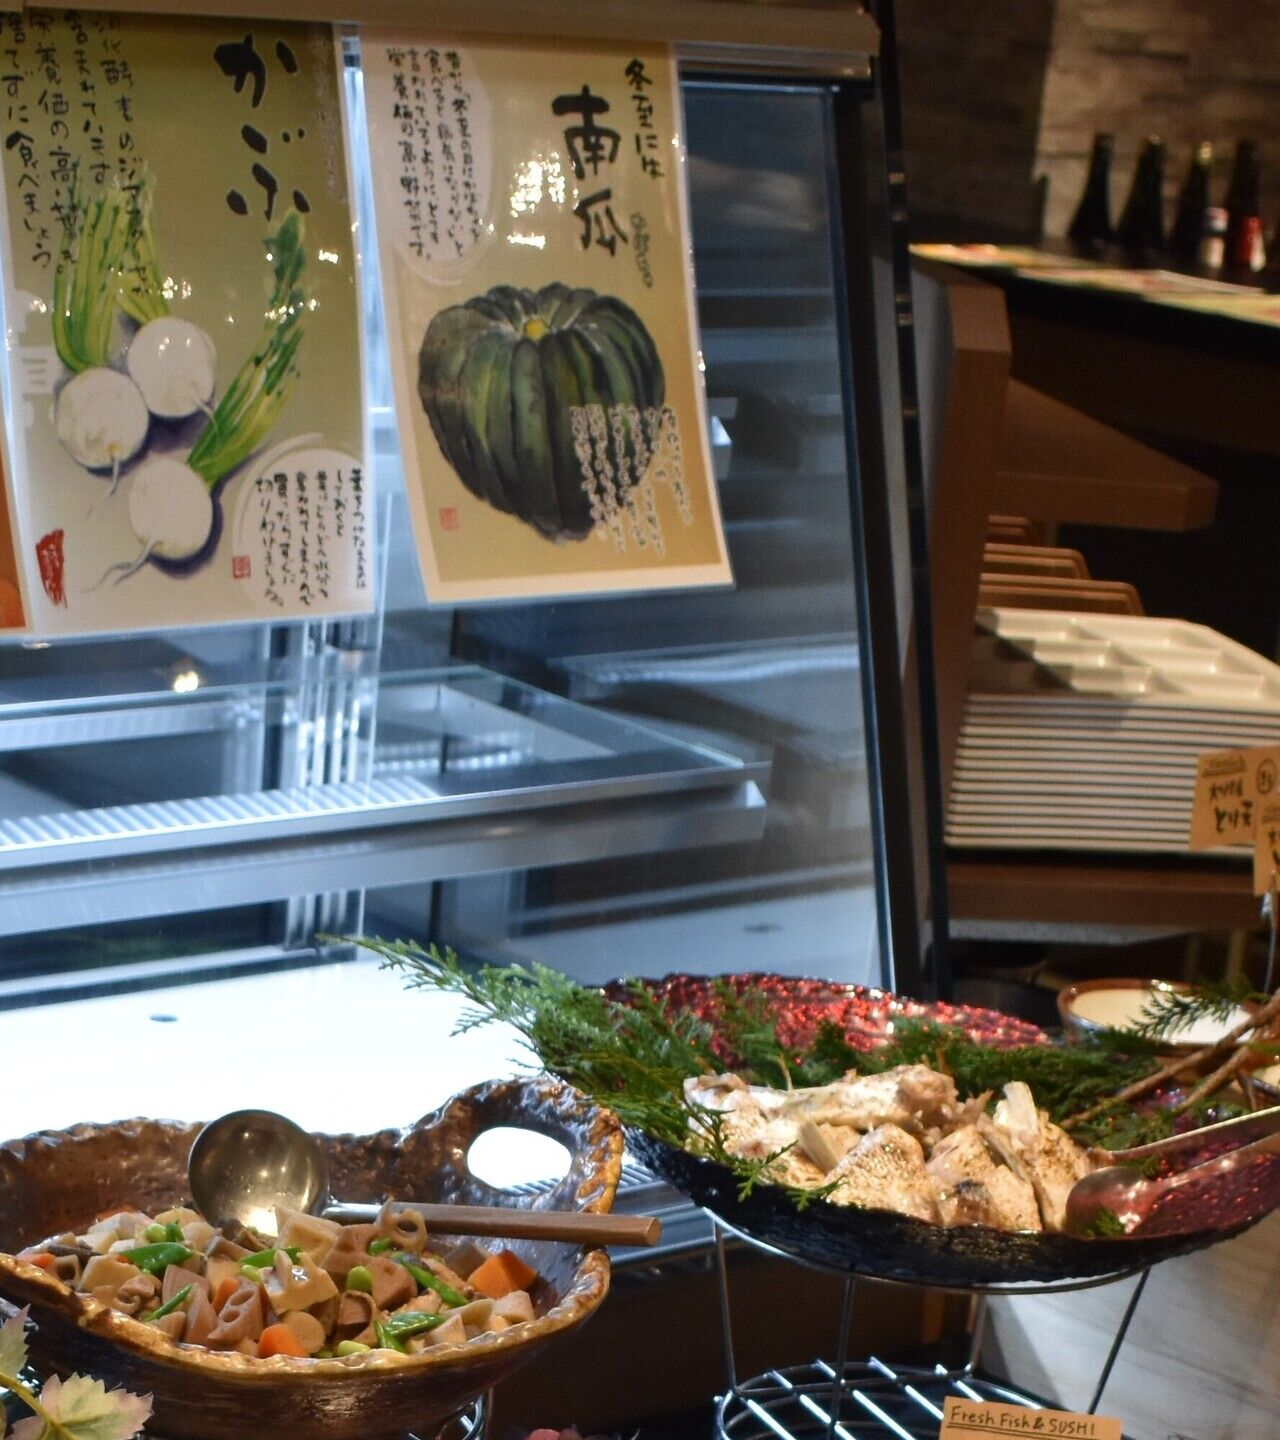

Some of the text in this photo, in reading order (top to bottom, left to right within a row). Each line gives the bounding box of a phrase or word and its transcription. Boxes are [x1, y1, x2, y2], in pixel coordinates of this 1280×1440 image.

[213, 31, 311, 222] かぶ
[552, 83, 628, 258] 南瓜
[950, 1405, 995, 1425] Fresh
[999, 1412, 1030, 1430] Fish
[1048, 1419, 1096, 1437] SUSHI
